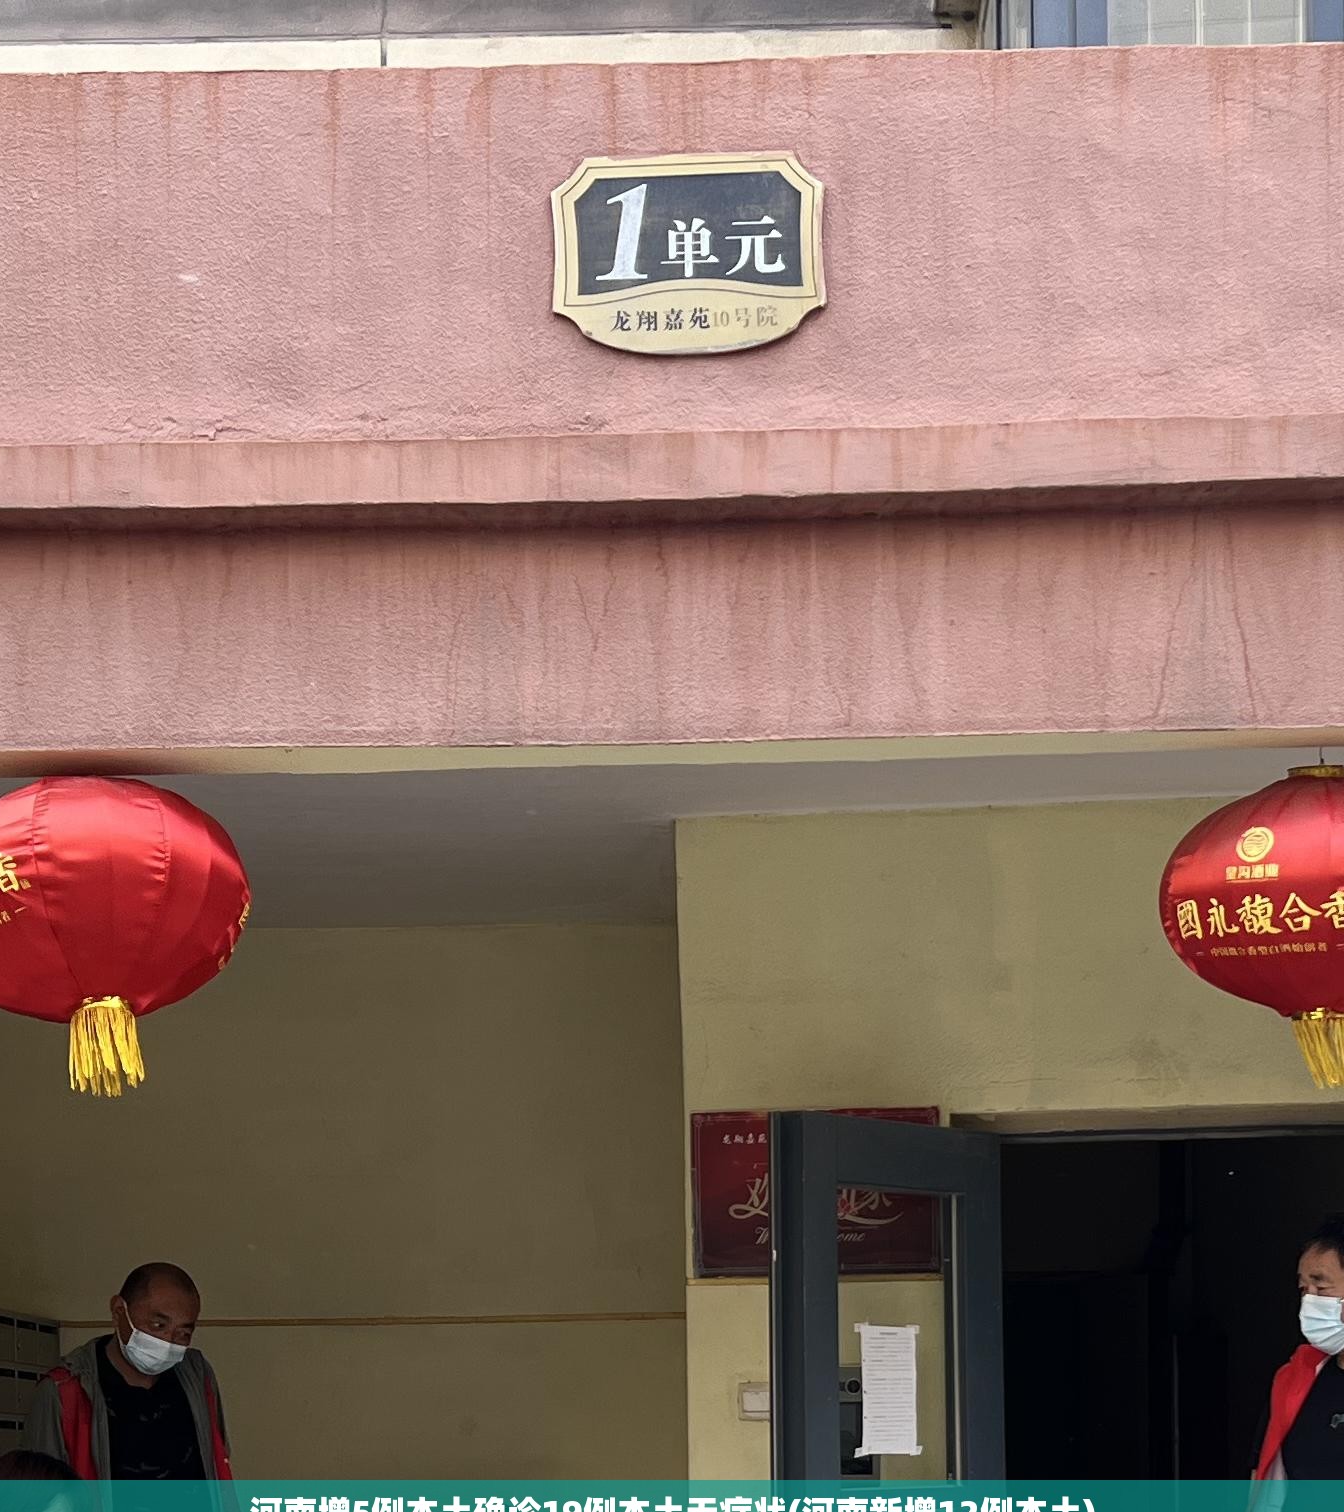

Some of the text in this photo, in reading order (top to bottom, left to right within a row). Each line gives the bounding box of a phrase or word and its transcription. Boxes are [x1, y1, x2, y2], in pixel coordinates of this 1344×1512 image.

[596, 183, 786, 281] 1单元
[610, 304, 779, 332] 龙翔嘉苑10号院
